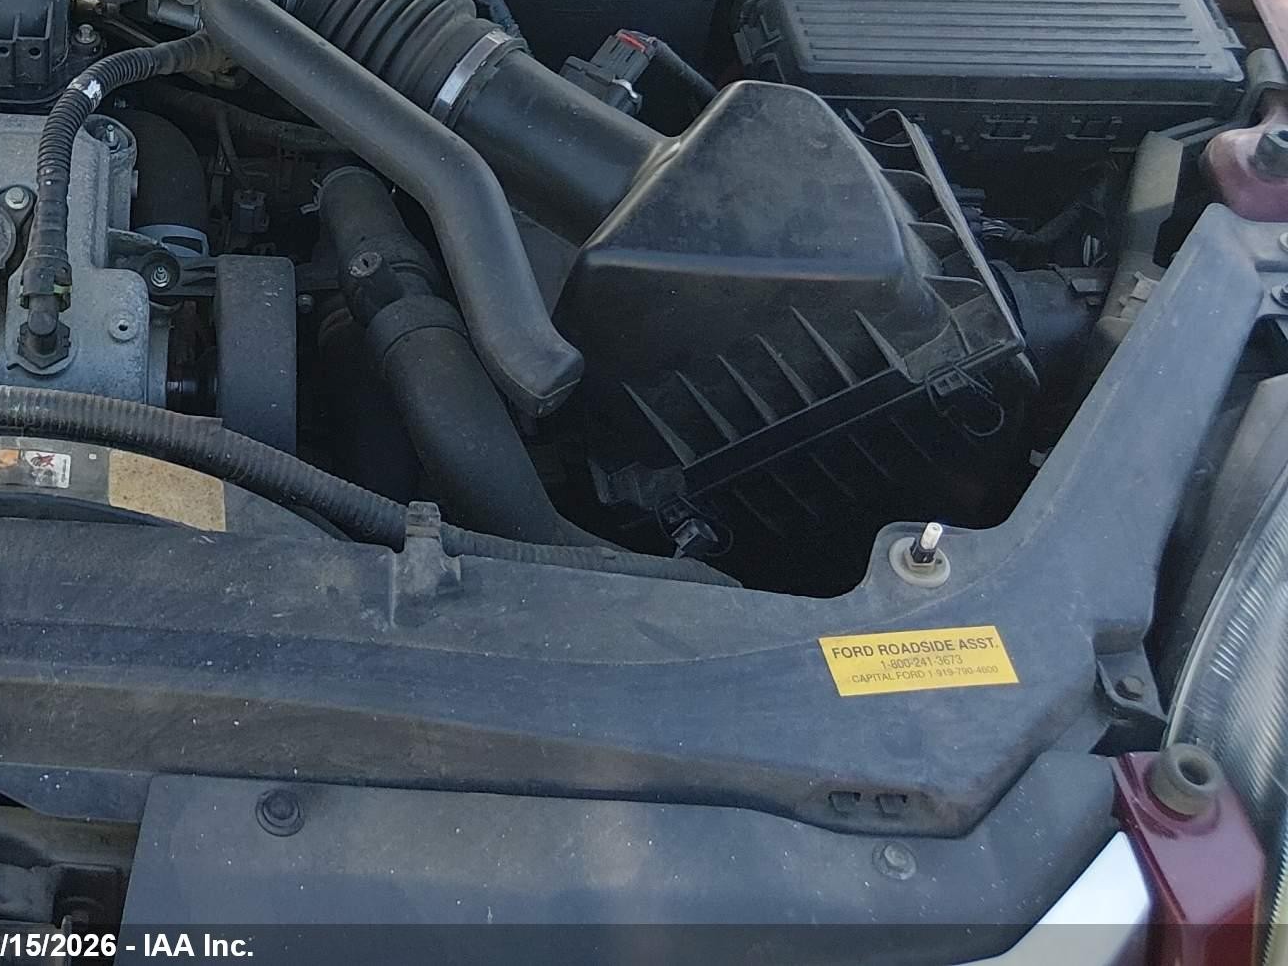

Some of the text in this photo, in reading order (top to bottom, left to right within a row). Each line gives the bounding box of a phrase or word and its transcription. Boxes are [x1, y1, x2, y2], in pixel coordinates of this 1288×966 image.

[831, 637, 999, 659] FORD ROADSIDE ASST.
[881, 655, 964, 670] 1-800-241-3673
[851, 672, 895, 684] CAPITAL
[896, 670, 925, 681] FORD
